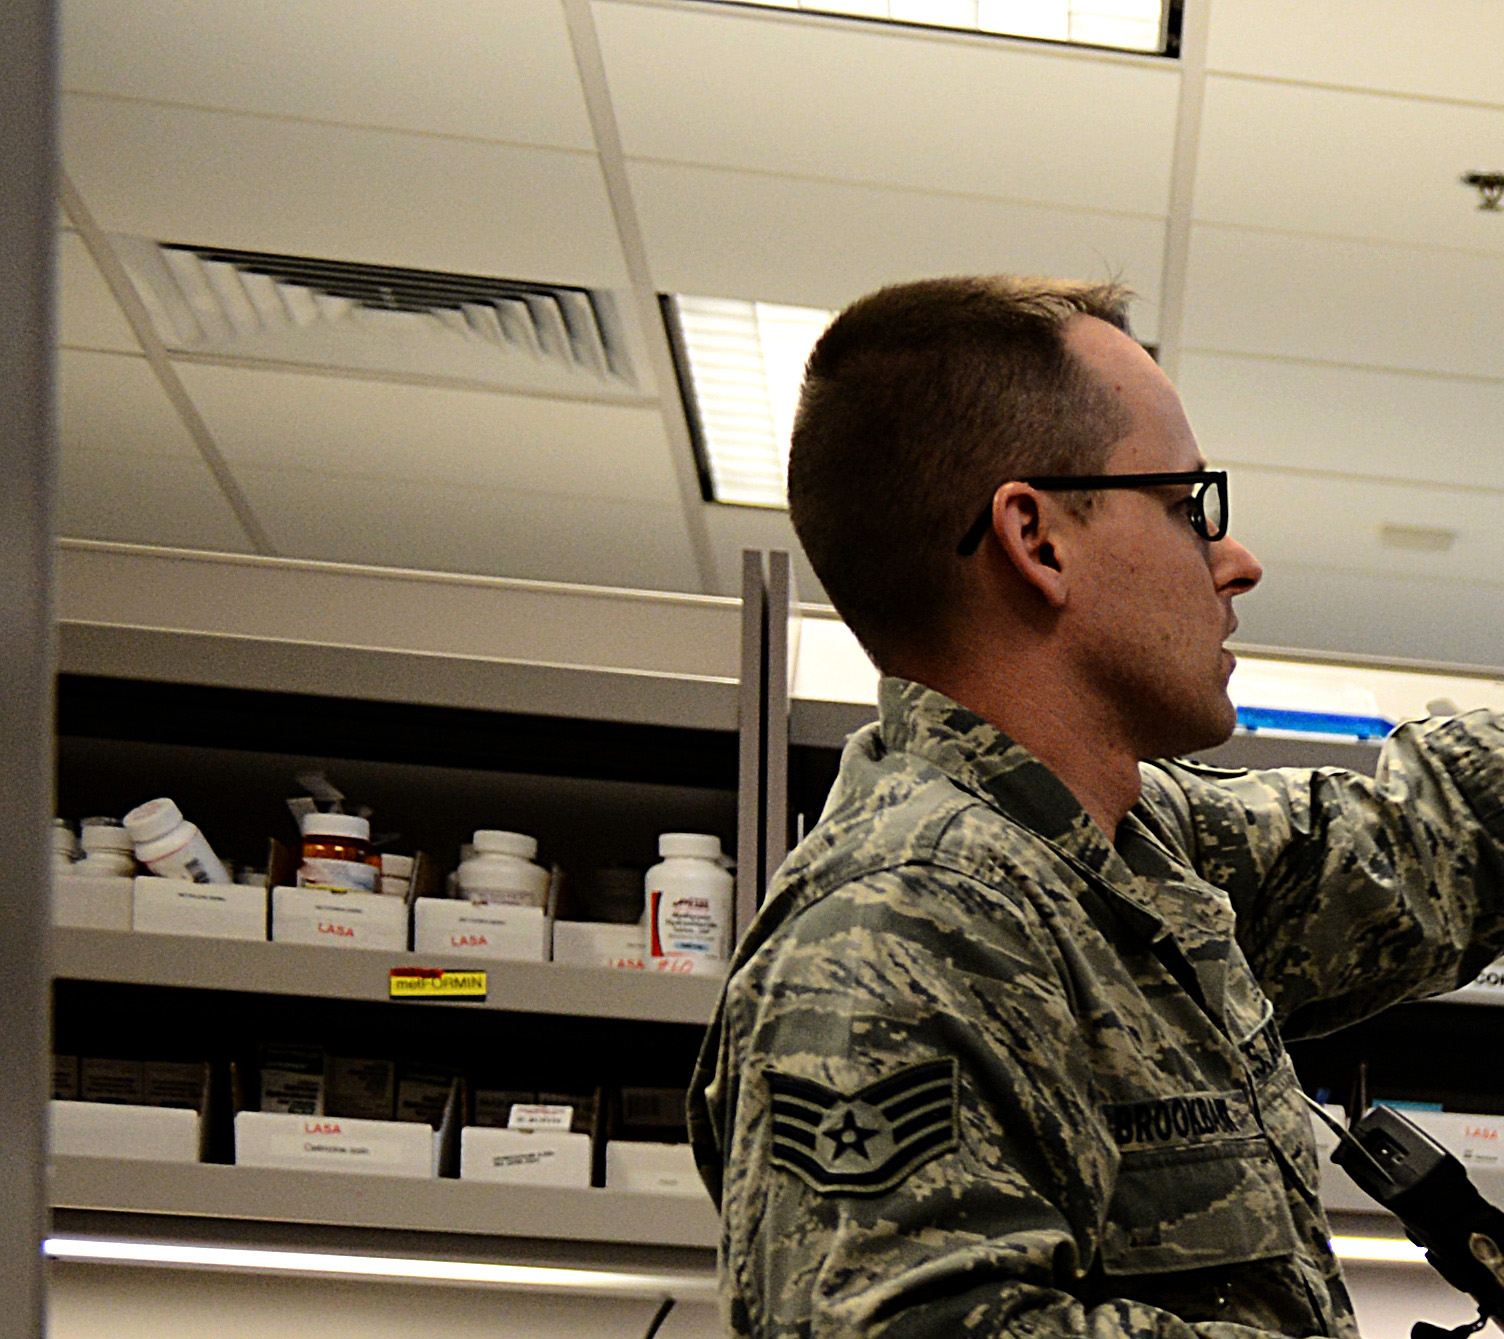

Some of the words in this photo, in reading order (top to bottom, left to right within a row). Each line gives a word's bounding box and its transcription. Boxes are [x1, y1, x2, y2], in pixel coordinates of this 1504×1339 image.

[317, 922, 354, 938] LASA
[450, 934, 488, 947] LASA
[304, 1123, 342, 1135] LASA
[1464, 1126, 1499, 1140] LASA
